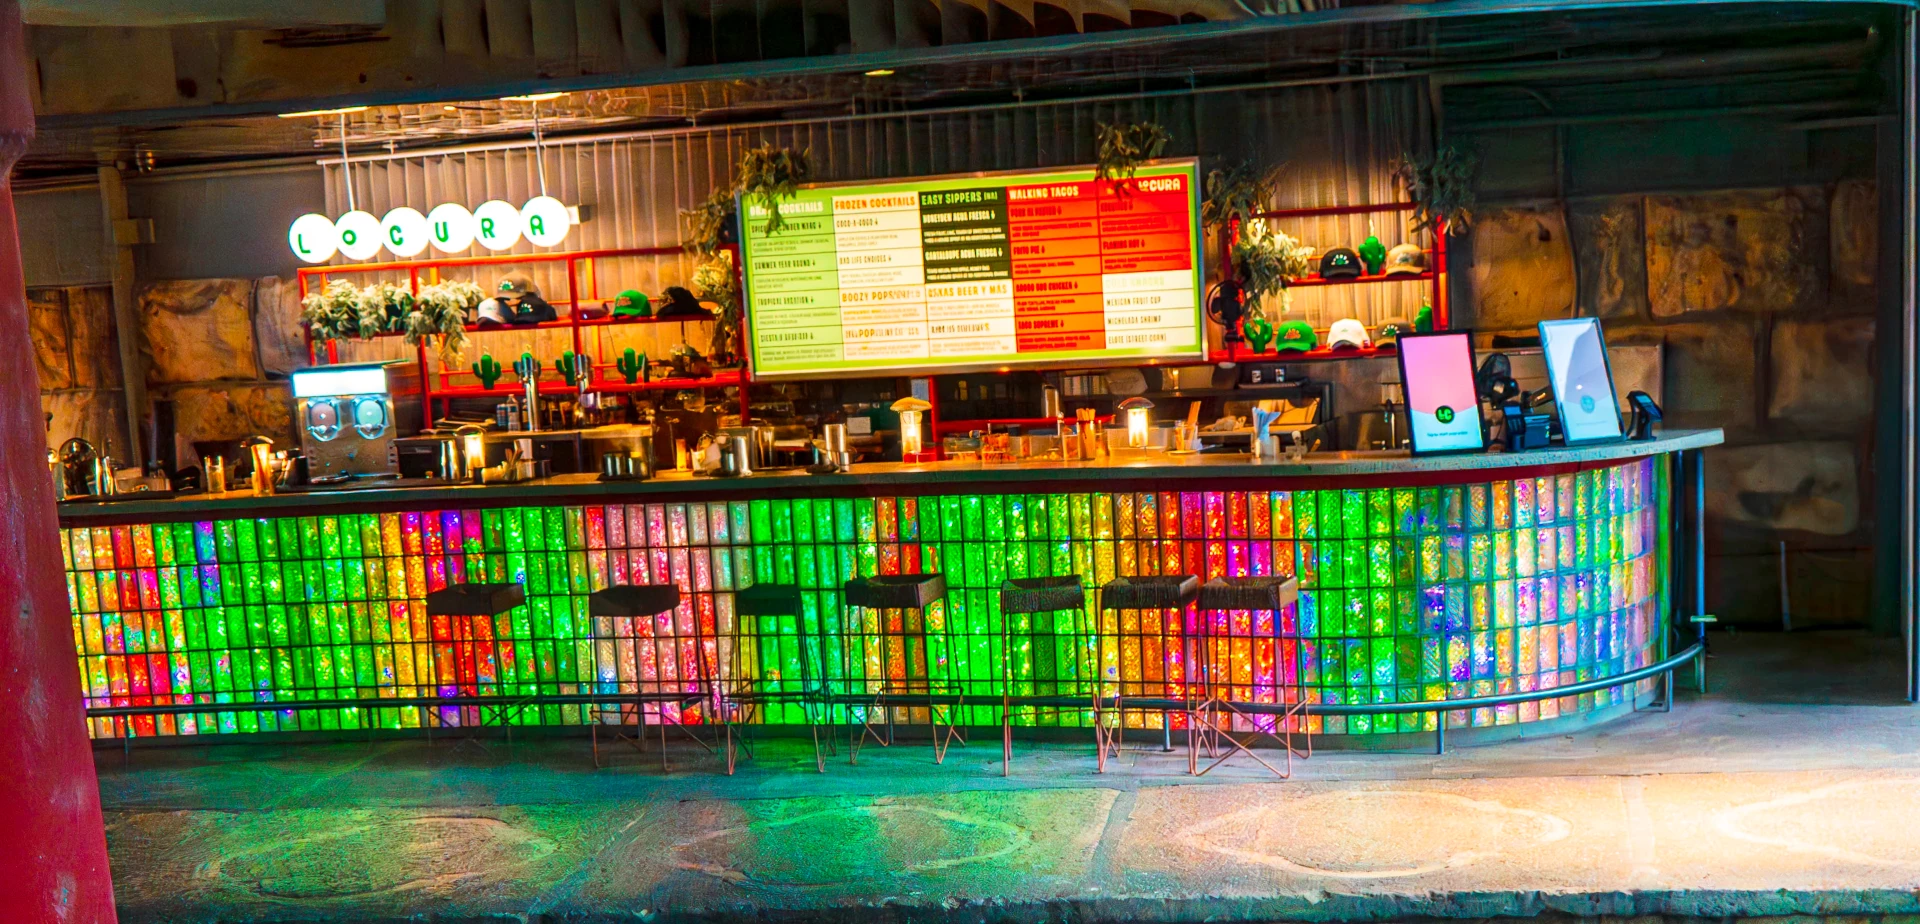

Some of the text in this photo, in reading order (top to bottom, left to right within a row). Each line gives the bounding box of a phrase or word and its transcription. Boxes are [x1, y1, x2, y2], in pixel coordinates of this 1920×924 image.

[921, 194, 943, 206] EASY
[945, 191, 982, 204] SIPPERS
[1009, 185, 1079, 200] WALKING TACOS
[835, 196, 916, 210] FROZEN COCKTAILS
[298, 214, 545, 254] LOCURA
